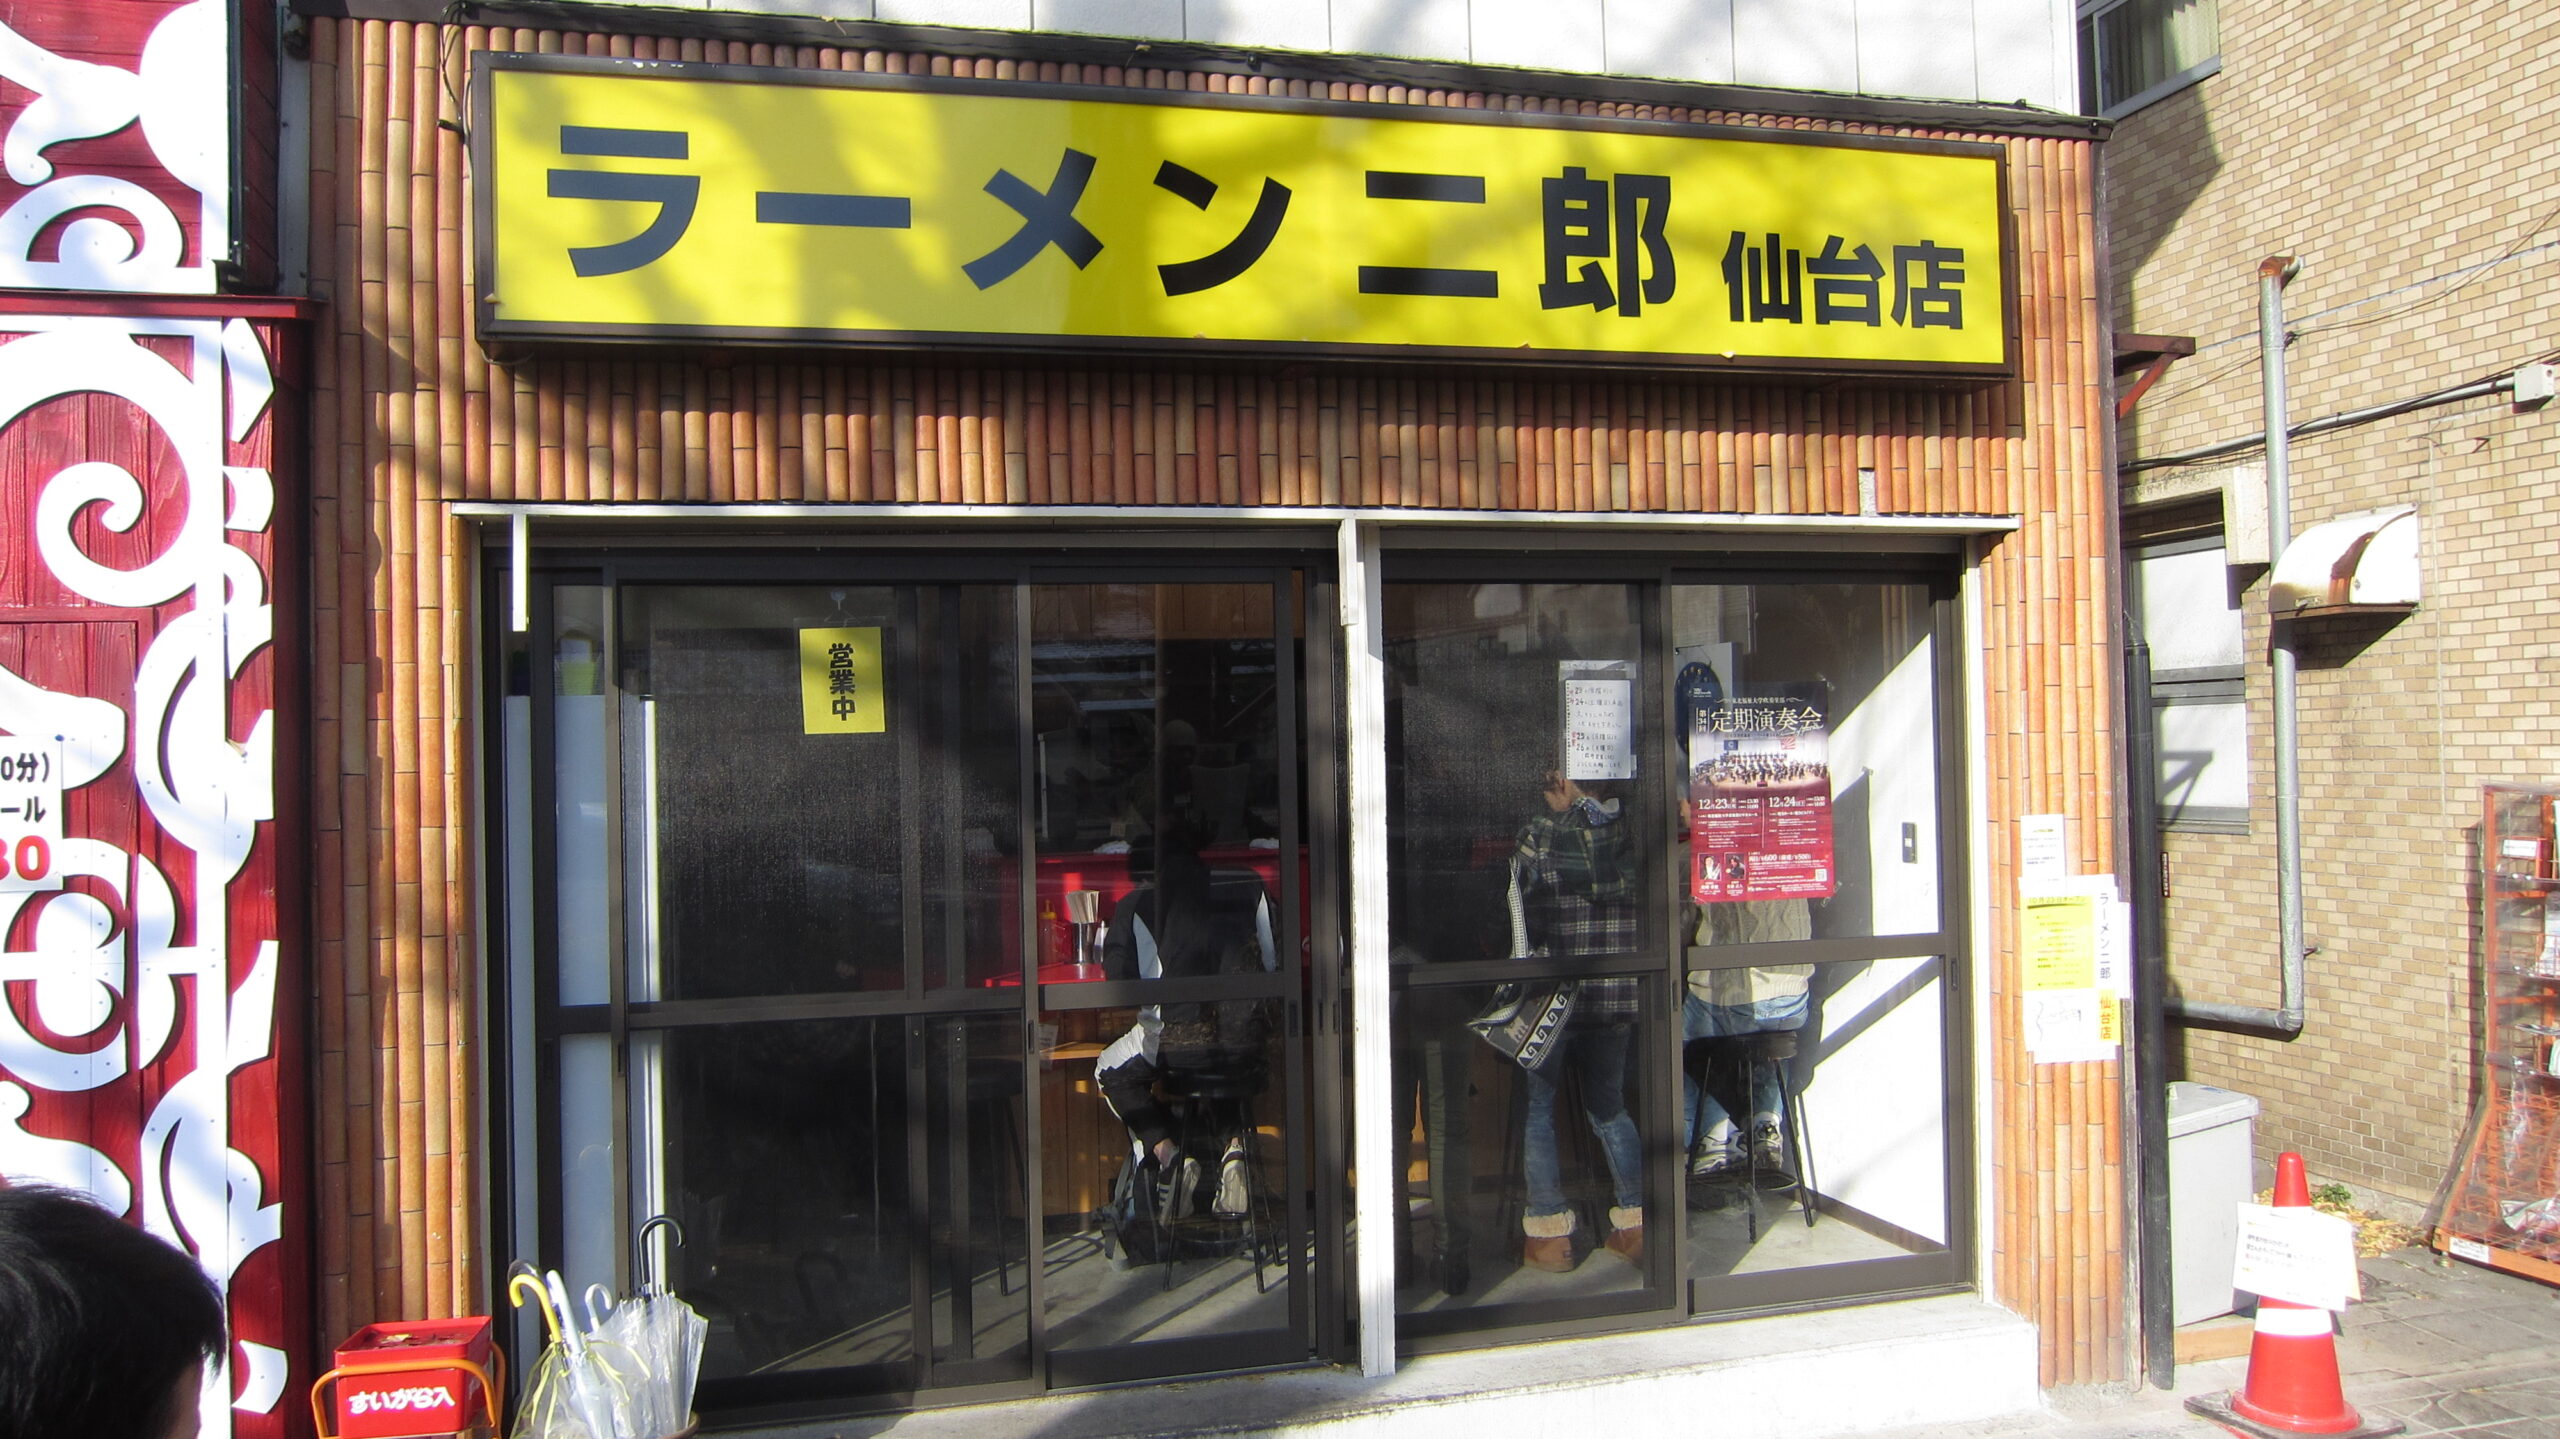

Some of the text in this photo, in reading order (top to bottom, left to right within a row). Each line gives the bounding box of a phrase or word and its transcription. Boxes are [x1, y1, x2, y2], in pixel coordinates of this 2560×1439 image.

[547, 124, 1966, 331] ラーメン二郎 仙台店
[828, 643, 856, 721] 営業中
[1710, 706, 1823, 733] 定期演奏会
[0, 796, 47, 823] ール
[2099, 893, 2111, 980] ラーメン二郎
[348, 1386, 456, 1415] すいがら入
